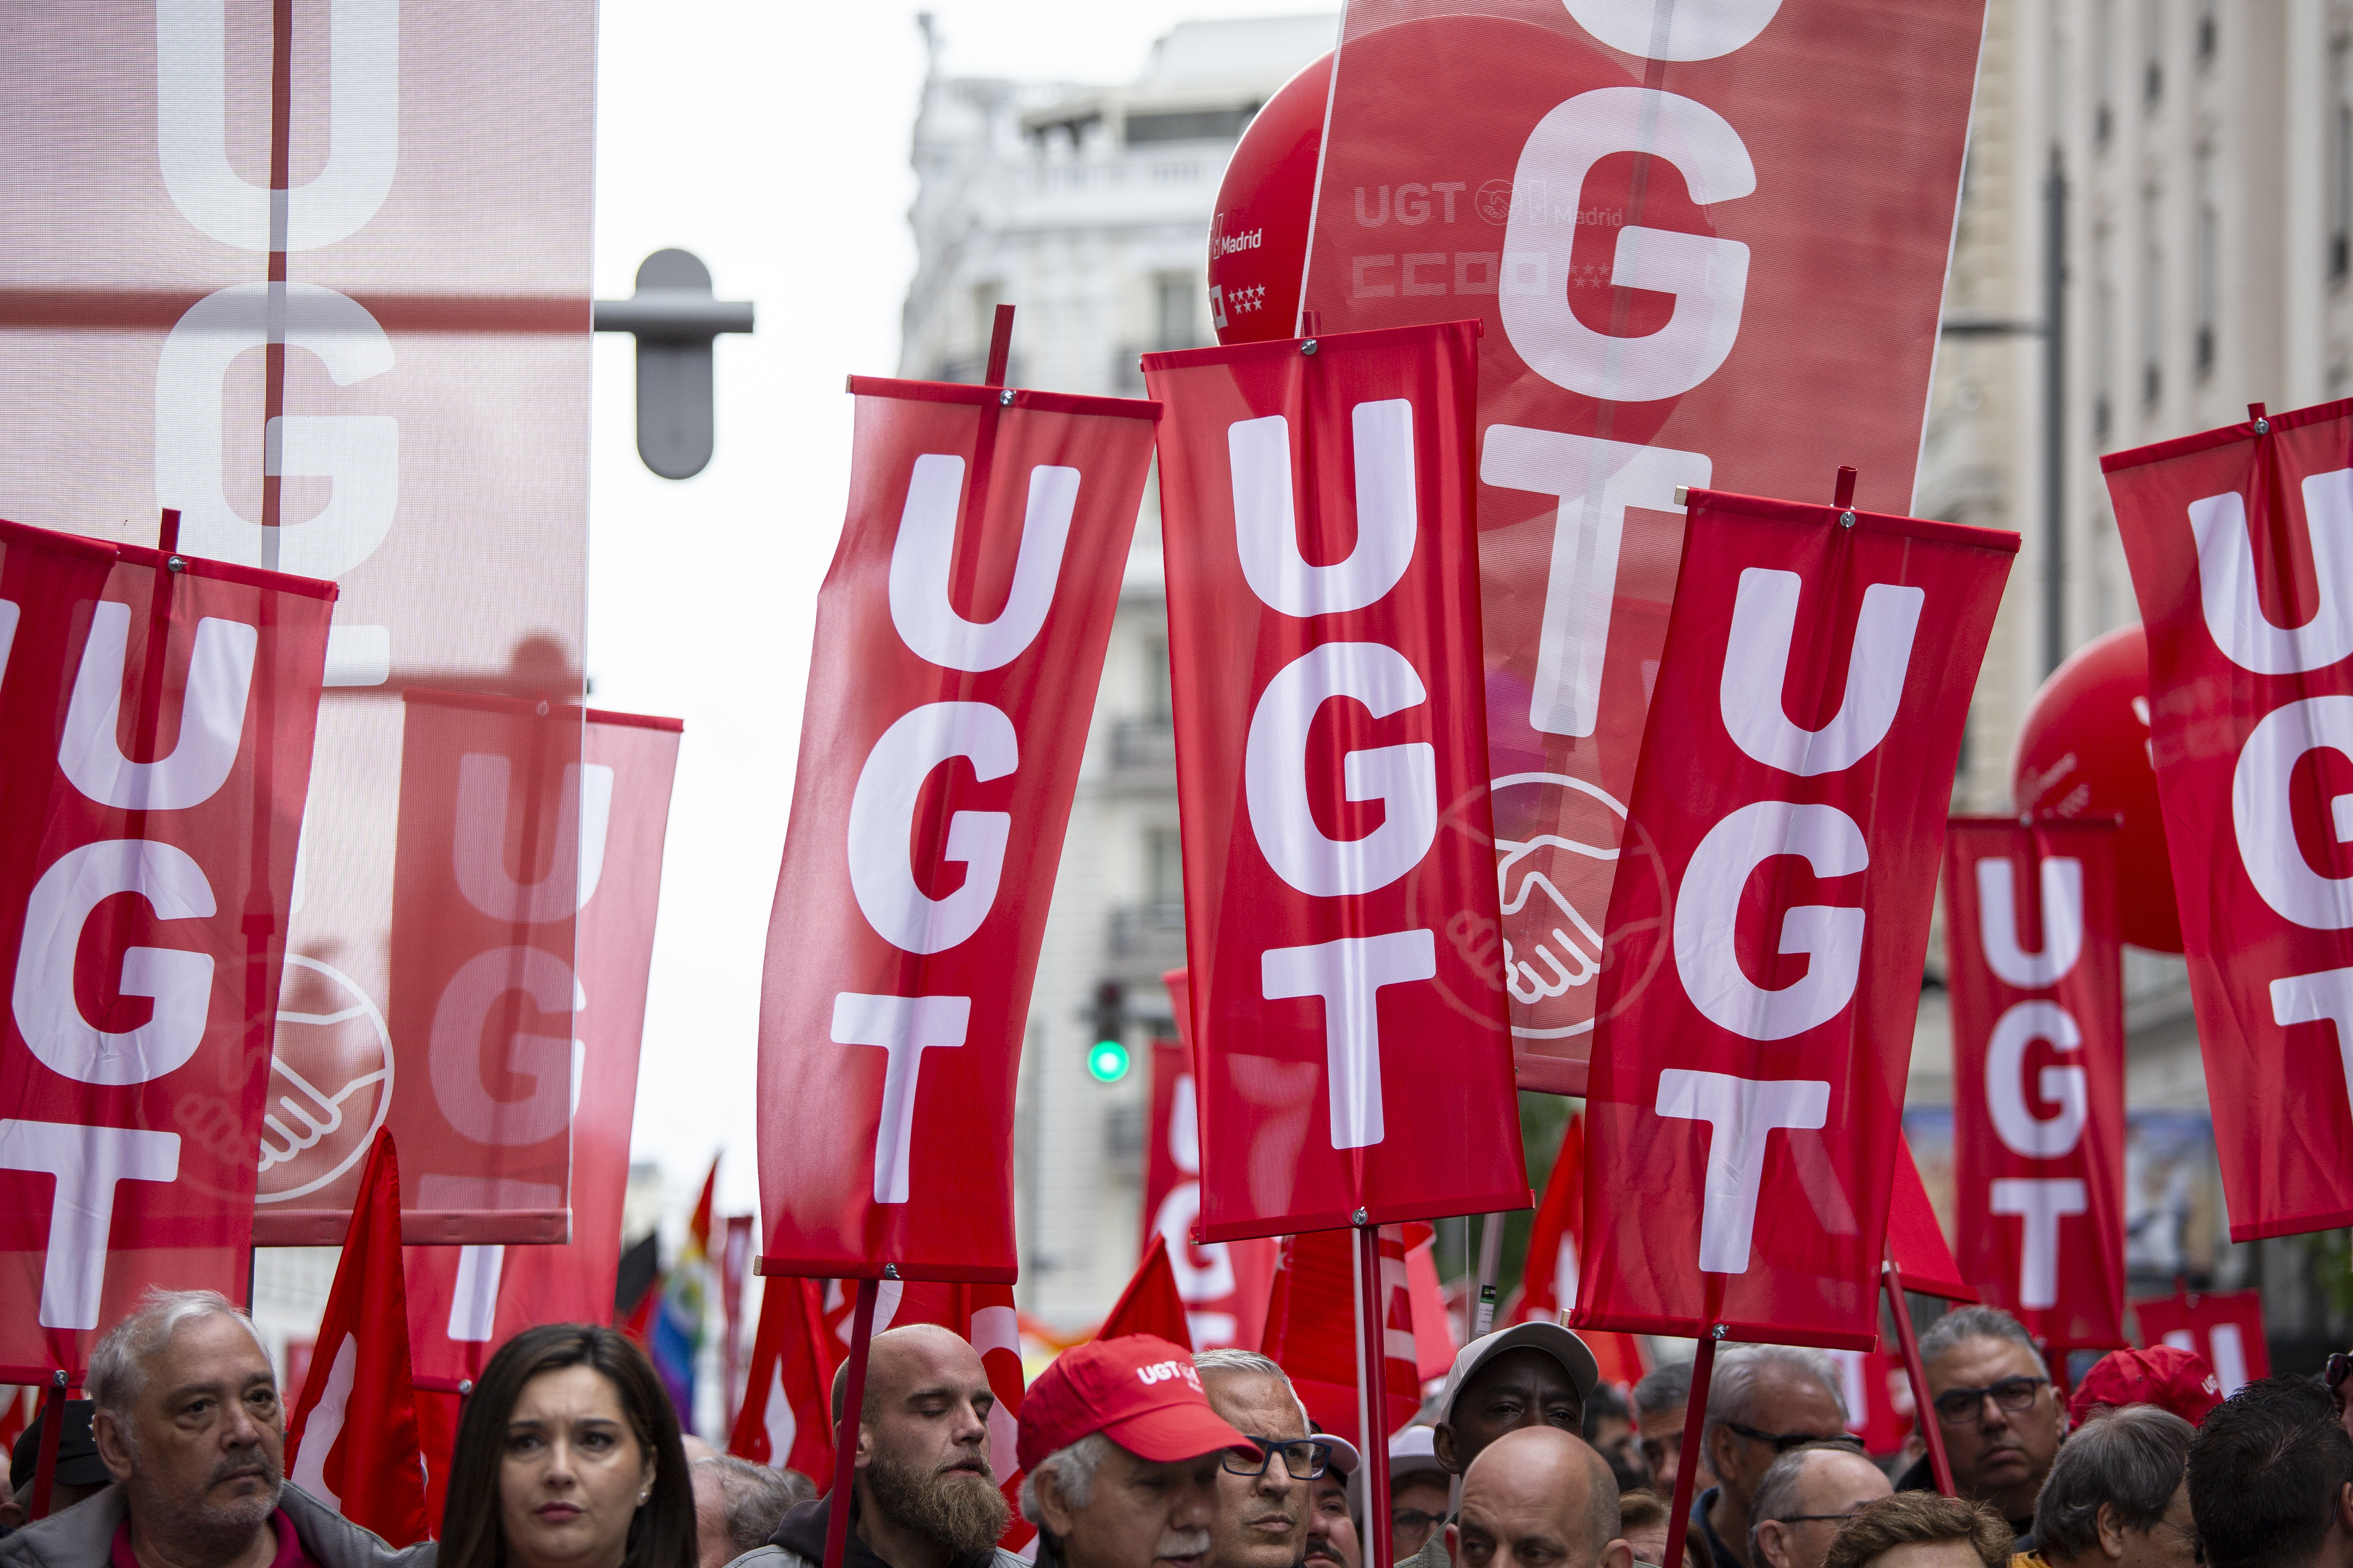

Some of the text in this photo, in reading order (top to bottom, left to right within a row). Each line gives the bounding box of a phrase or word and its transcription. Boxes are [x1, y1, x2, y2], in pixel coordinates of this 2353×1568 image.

[1222, 227, 1263, 255] Madrid
[1354, 181, 1467, 228] UGT
[1479, 0, 1784, 737] GT
[0, 600, 259, 1330] UGT
[416, 752, 614, 1342] UGT
[831, 453, 1081, 1204] UGT
[1228, 398, 1438, 1149] UGT
[1655, 567, 1925, 1274] UGT
[1977, 857, 2088, 1310] UGT
[2188, 467, 2353, 1126] UG
[1136, 1360, 1181, 1386] UGT
